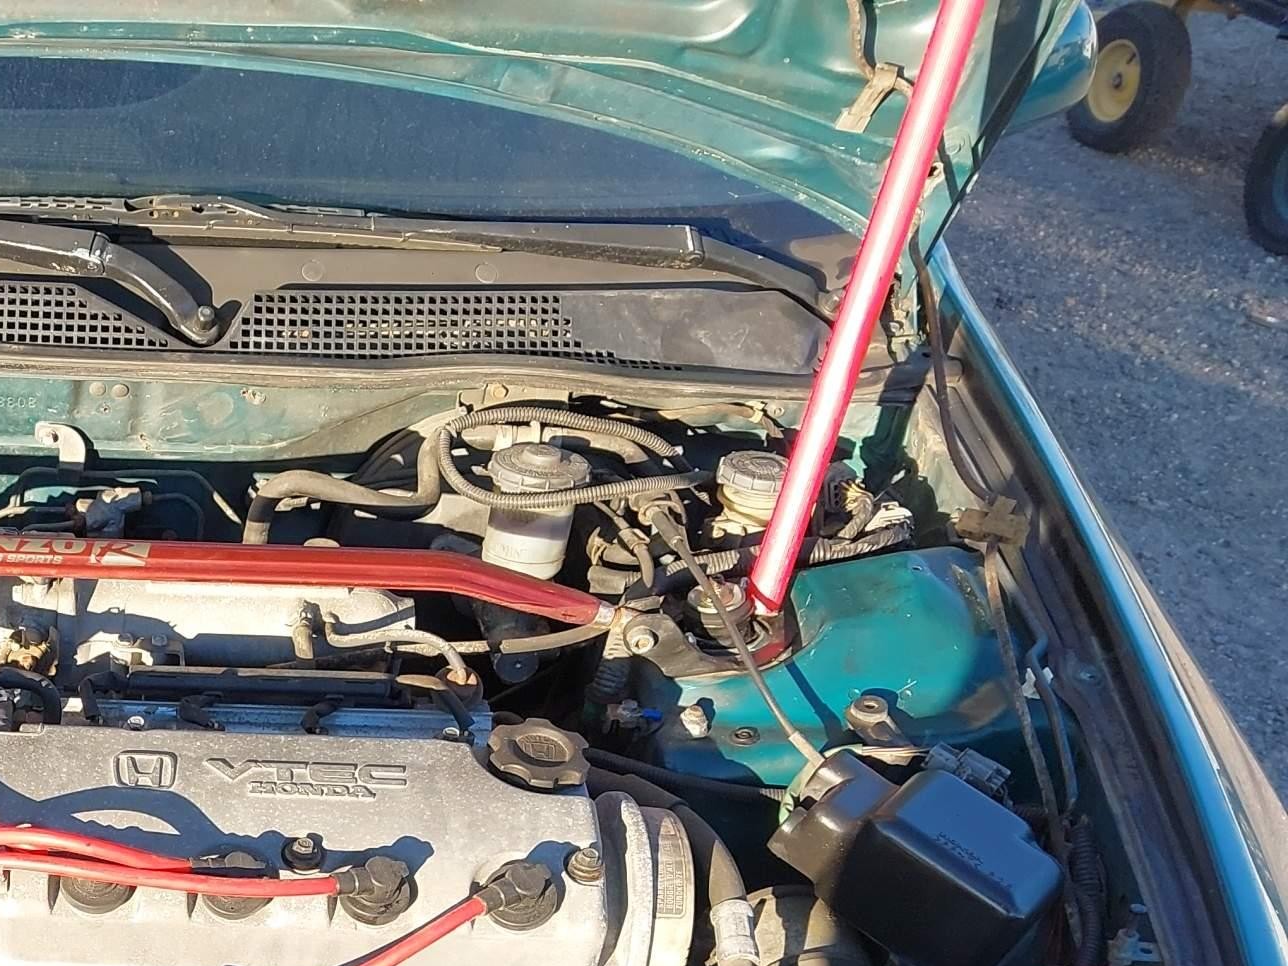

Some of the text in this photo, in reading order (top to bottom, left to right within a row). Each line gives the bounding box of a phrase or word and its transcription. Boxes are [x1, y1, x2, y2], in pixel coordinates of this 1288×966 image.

[6, 554, 64, 565] SPORTS
[205, 757, 408, 787] VTEC
[249, 780, 377, 799] HONDA
